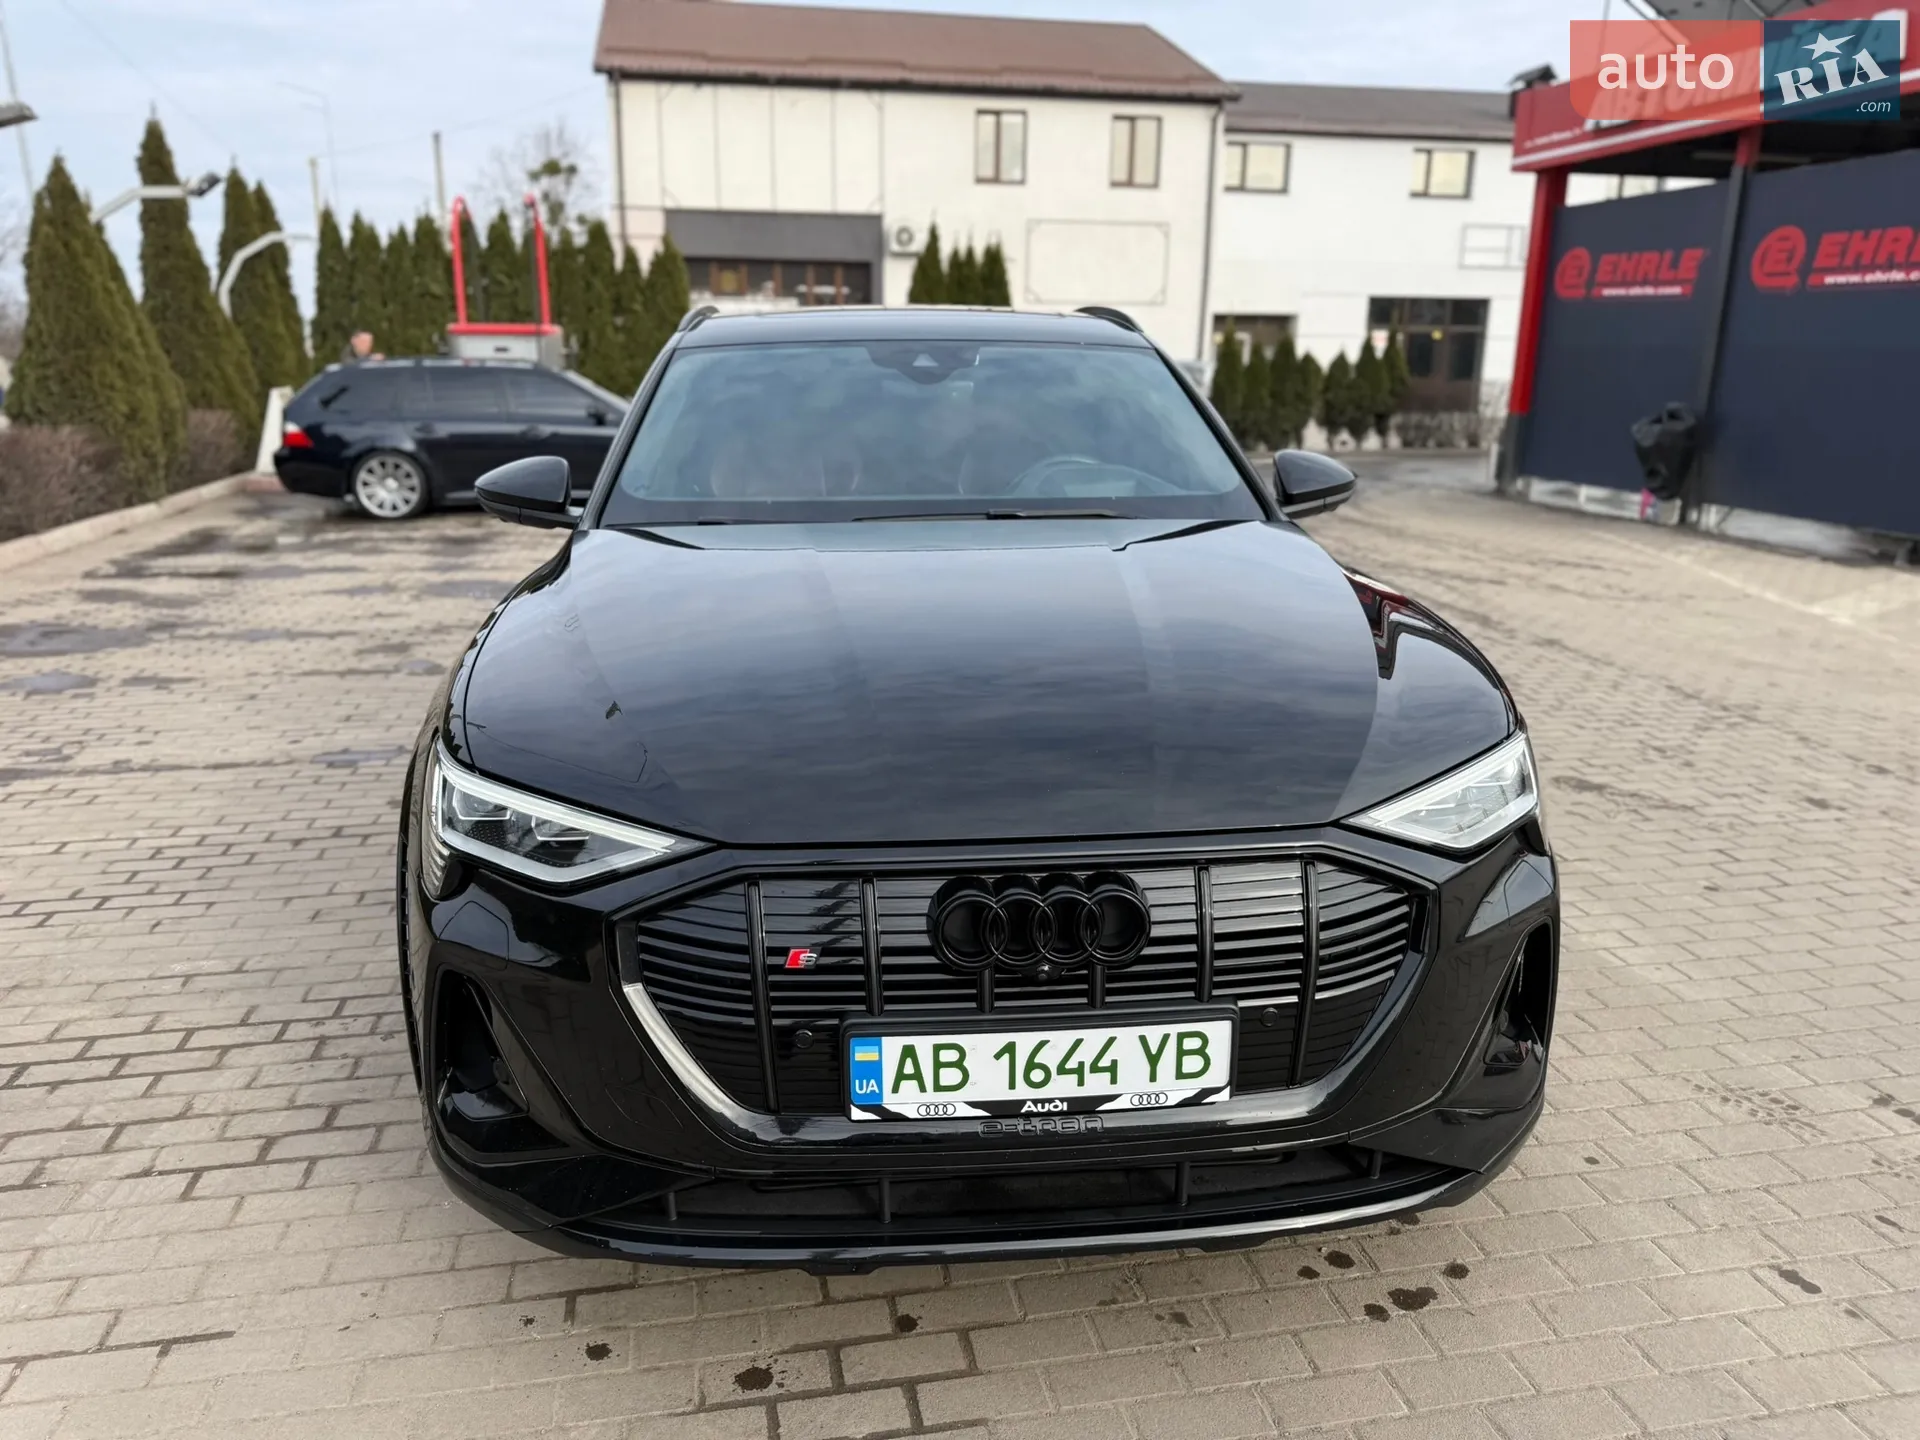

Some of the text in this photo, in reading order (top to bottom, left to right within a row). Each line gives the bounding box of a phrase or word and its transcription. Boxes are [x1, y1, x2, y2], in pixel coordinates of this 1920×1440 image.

[1595, 248, 1704, 281] EHRLE
[891, 1031, 1211, 1094] AB 1644 YB
[855, 1079, 879, 1094] UA
[1020, 1100, 1068, 1113] Audi
[979, 1115, 1104, 1137] e-tron
